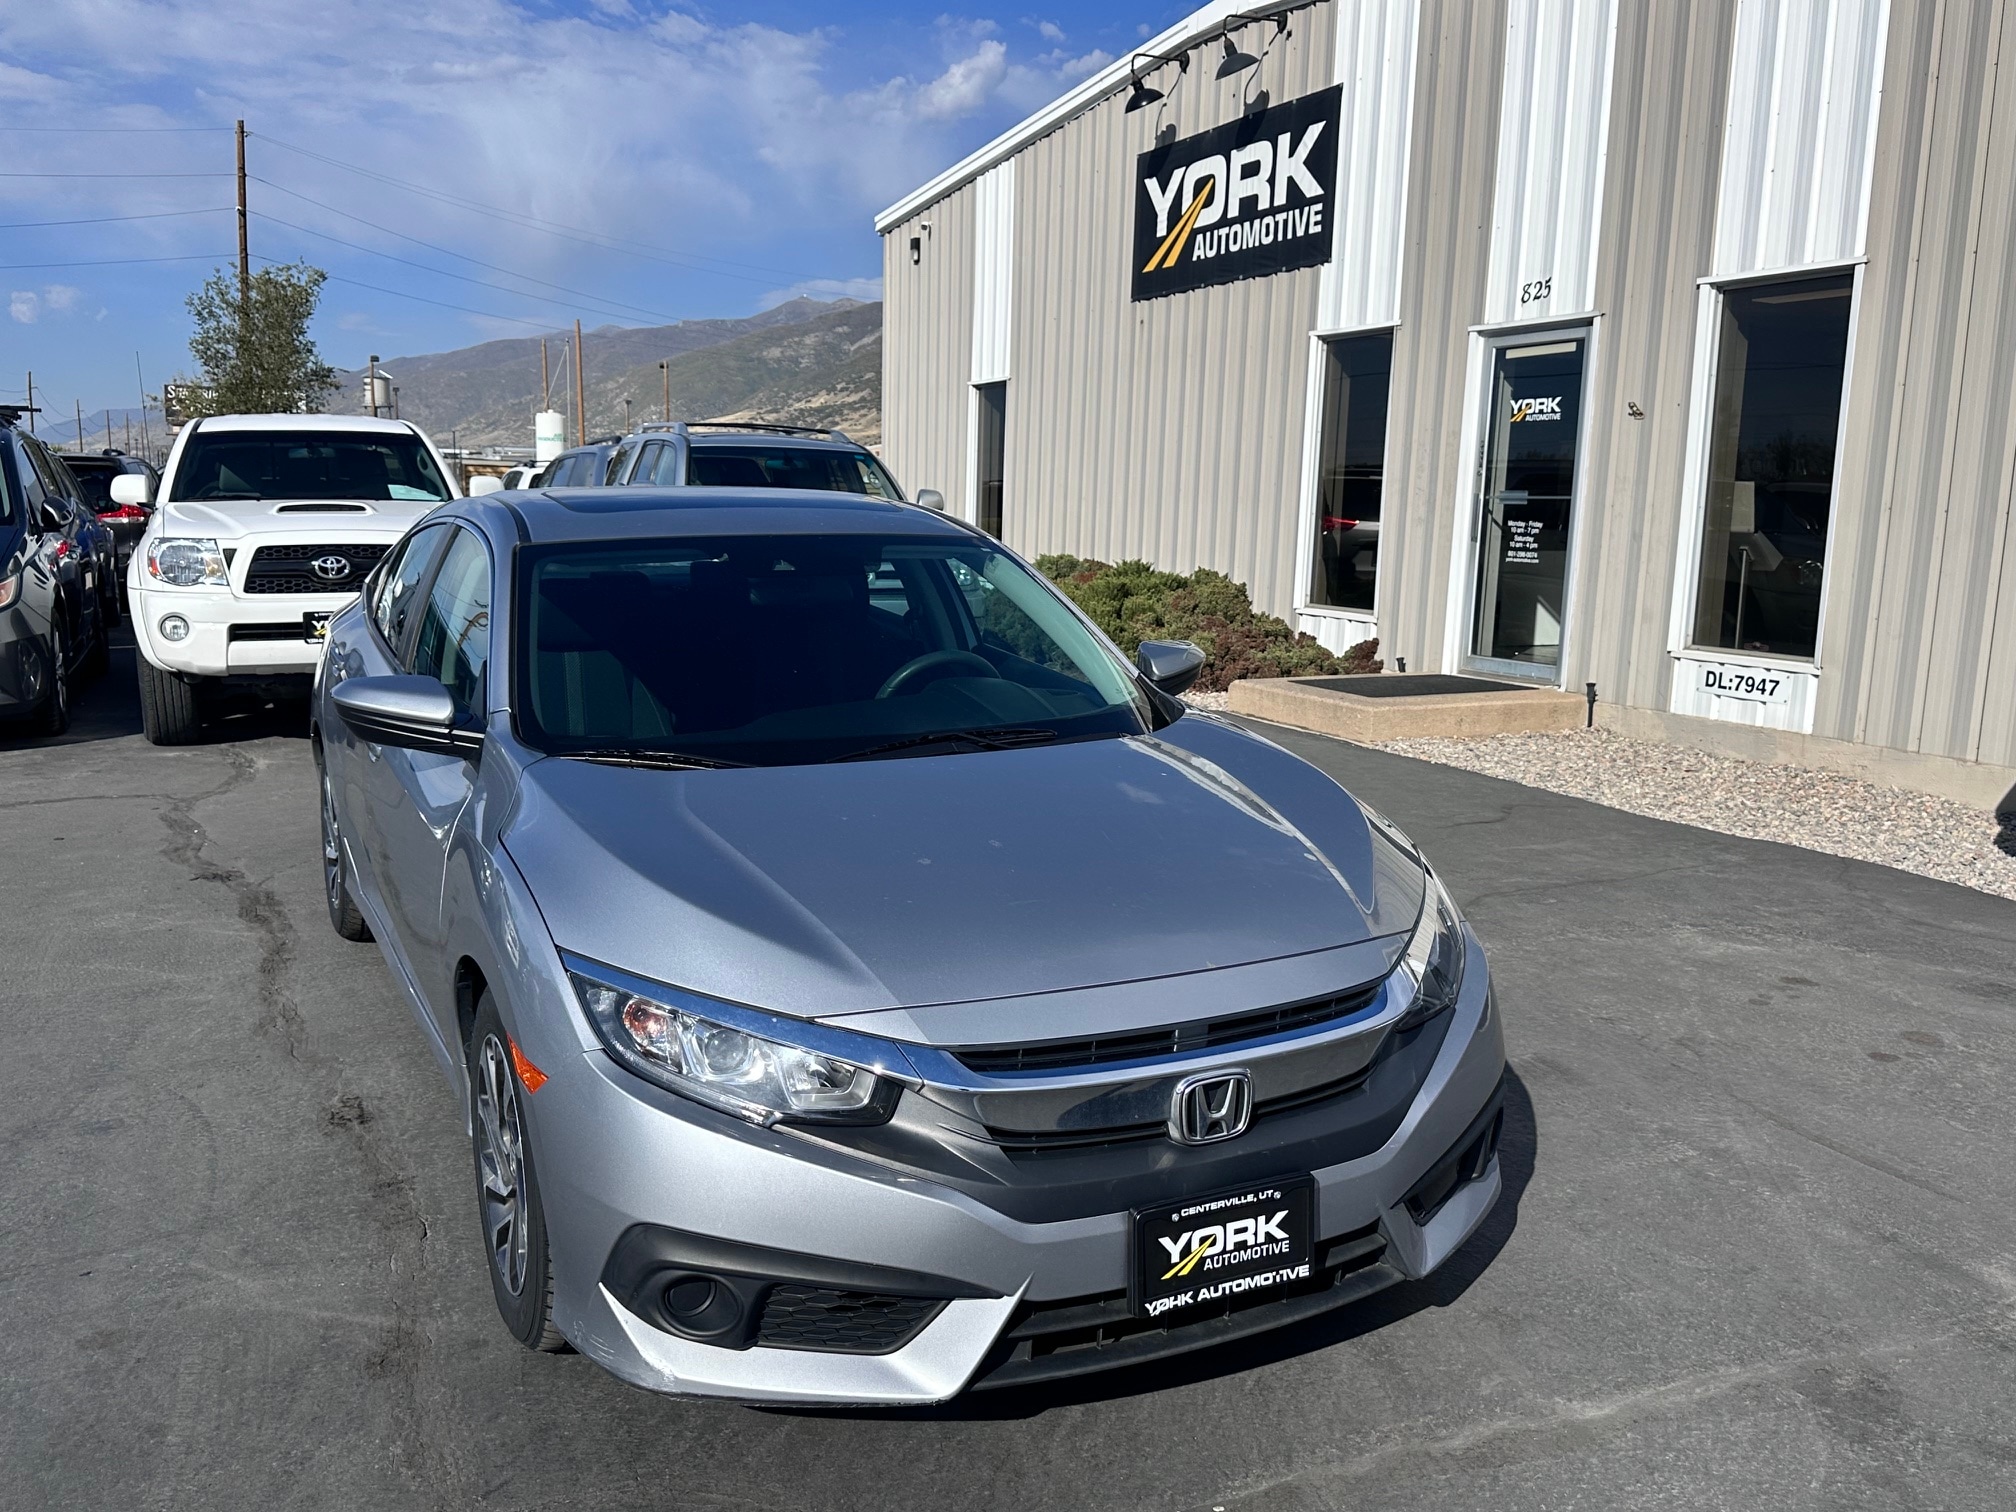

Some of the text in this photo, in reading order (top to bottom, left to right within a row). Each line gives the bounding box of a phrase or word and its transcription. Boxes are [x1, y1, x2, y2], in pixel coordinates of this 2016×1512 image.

[1144, 120, 1327, 238] YORK
[1192, 202, 1323, 261] AUTOMOTIVE
[1521, 276, 1552, 304] 825
[1510, 396, 1562, 414] YORK
[1525, 412, 1561, 421] AUTOMOTIVE
[1529, 520, 1544, 528] Friday
[1514, 534, 1534, 542] Saturday
[1705, 670, 1780, 696] DL:7947
[1181, 1190, 1274, 1217] CENTERVILLE, UT
[1158, 1210, 1289, 1263] YORK
[1203, 1240, 1290, 1271] AUTOMOTIVE
[1197, 1264, 1310, 1301] AUTOMOTIVE
